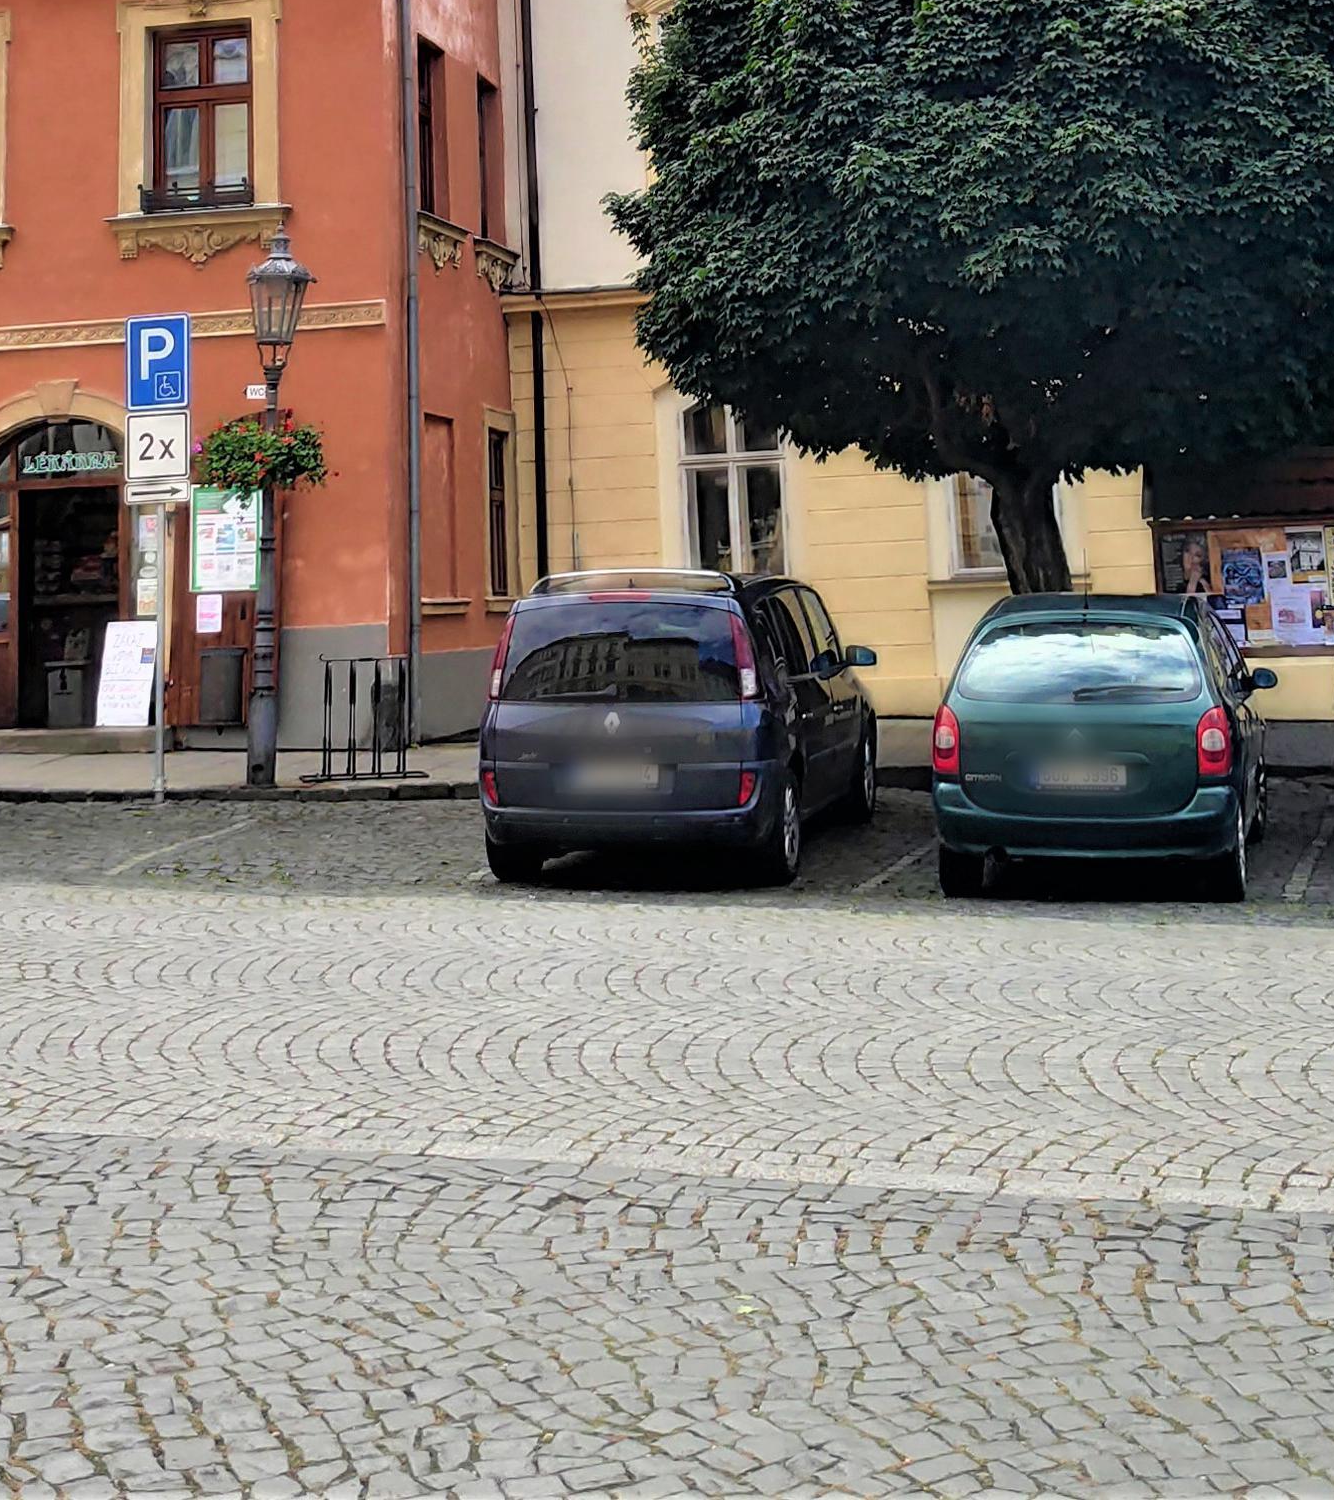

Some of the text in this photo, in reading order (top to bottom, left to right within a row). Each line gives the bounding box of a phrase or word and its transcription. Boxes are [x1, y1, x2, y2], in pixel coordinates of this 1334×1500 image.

[140, 327, 175, 381] P
[250, 387, 265, 396] WC
[139, 433, 175, 461] 2x
[22, 450, 118, 473] LÉKÁRNA
